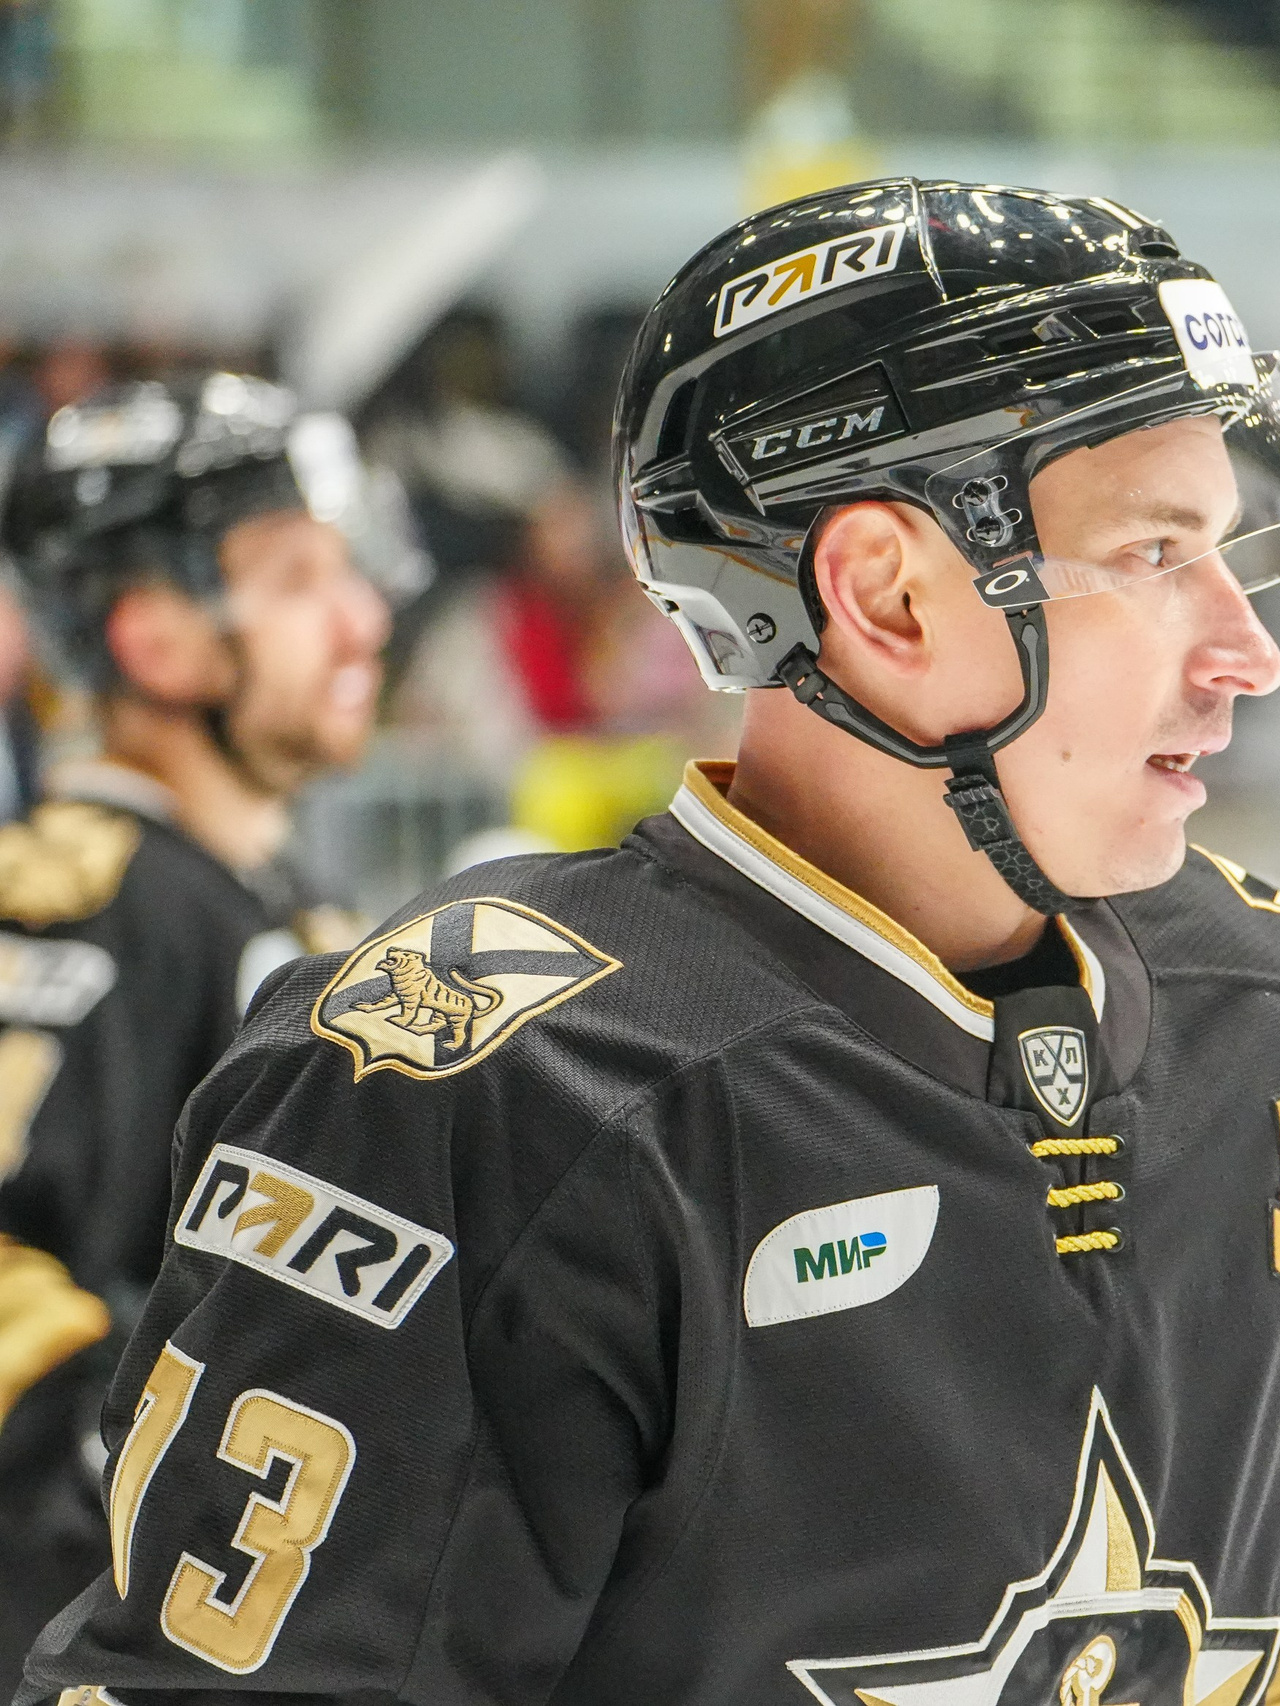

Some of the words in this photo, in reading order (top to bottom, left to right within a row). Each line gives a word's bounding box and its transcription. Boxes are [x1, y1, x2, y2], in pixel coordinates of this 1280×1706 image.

[720, 229, 897, 330] PARI
[751, 405, 886, 461] CCM
[185, 1158, 433, 1313] PARI
[793, 1231, 887, 1284] МИР
